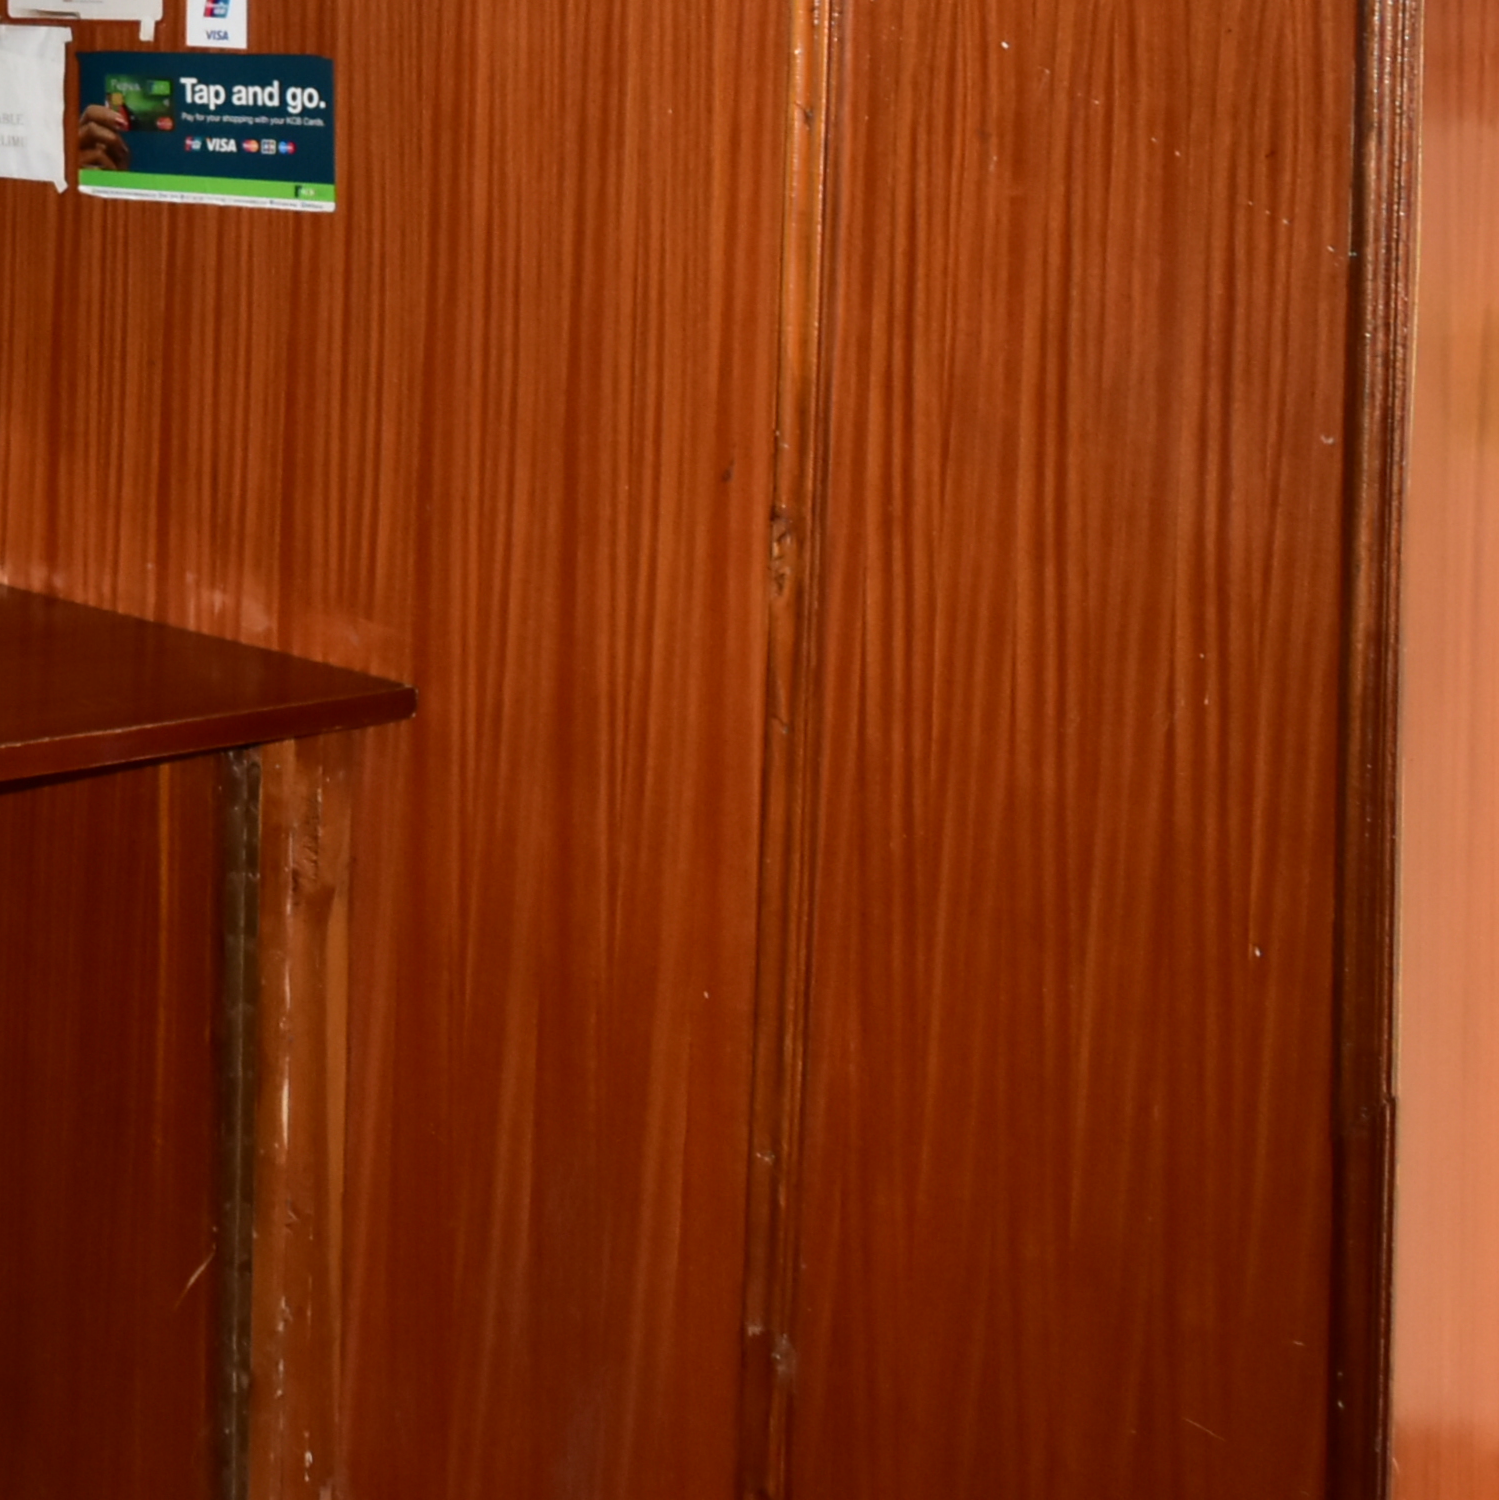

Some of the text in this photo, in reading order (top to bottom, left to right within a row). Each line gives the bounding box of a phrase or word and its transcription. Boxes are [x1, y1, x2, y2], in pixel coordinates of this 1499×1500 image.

[206, 30, 229, 40] VISA
[179, 77, 327, 114] Tap and go.
[181, 112, 194, 122] Pay
[195, 113, 206, 121] for
[206, 114, 221, 123] your
[222, 114, 253, 125] shopping
[254, 116, 269, 124] with
[270, 117, 285, 126] your
[286, 117, 303, 125] KCB
[206, 138, 237, 152] VISA
